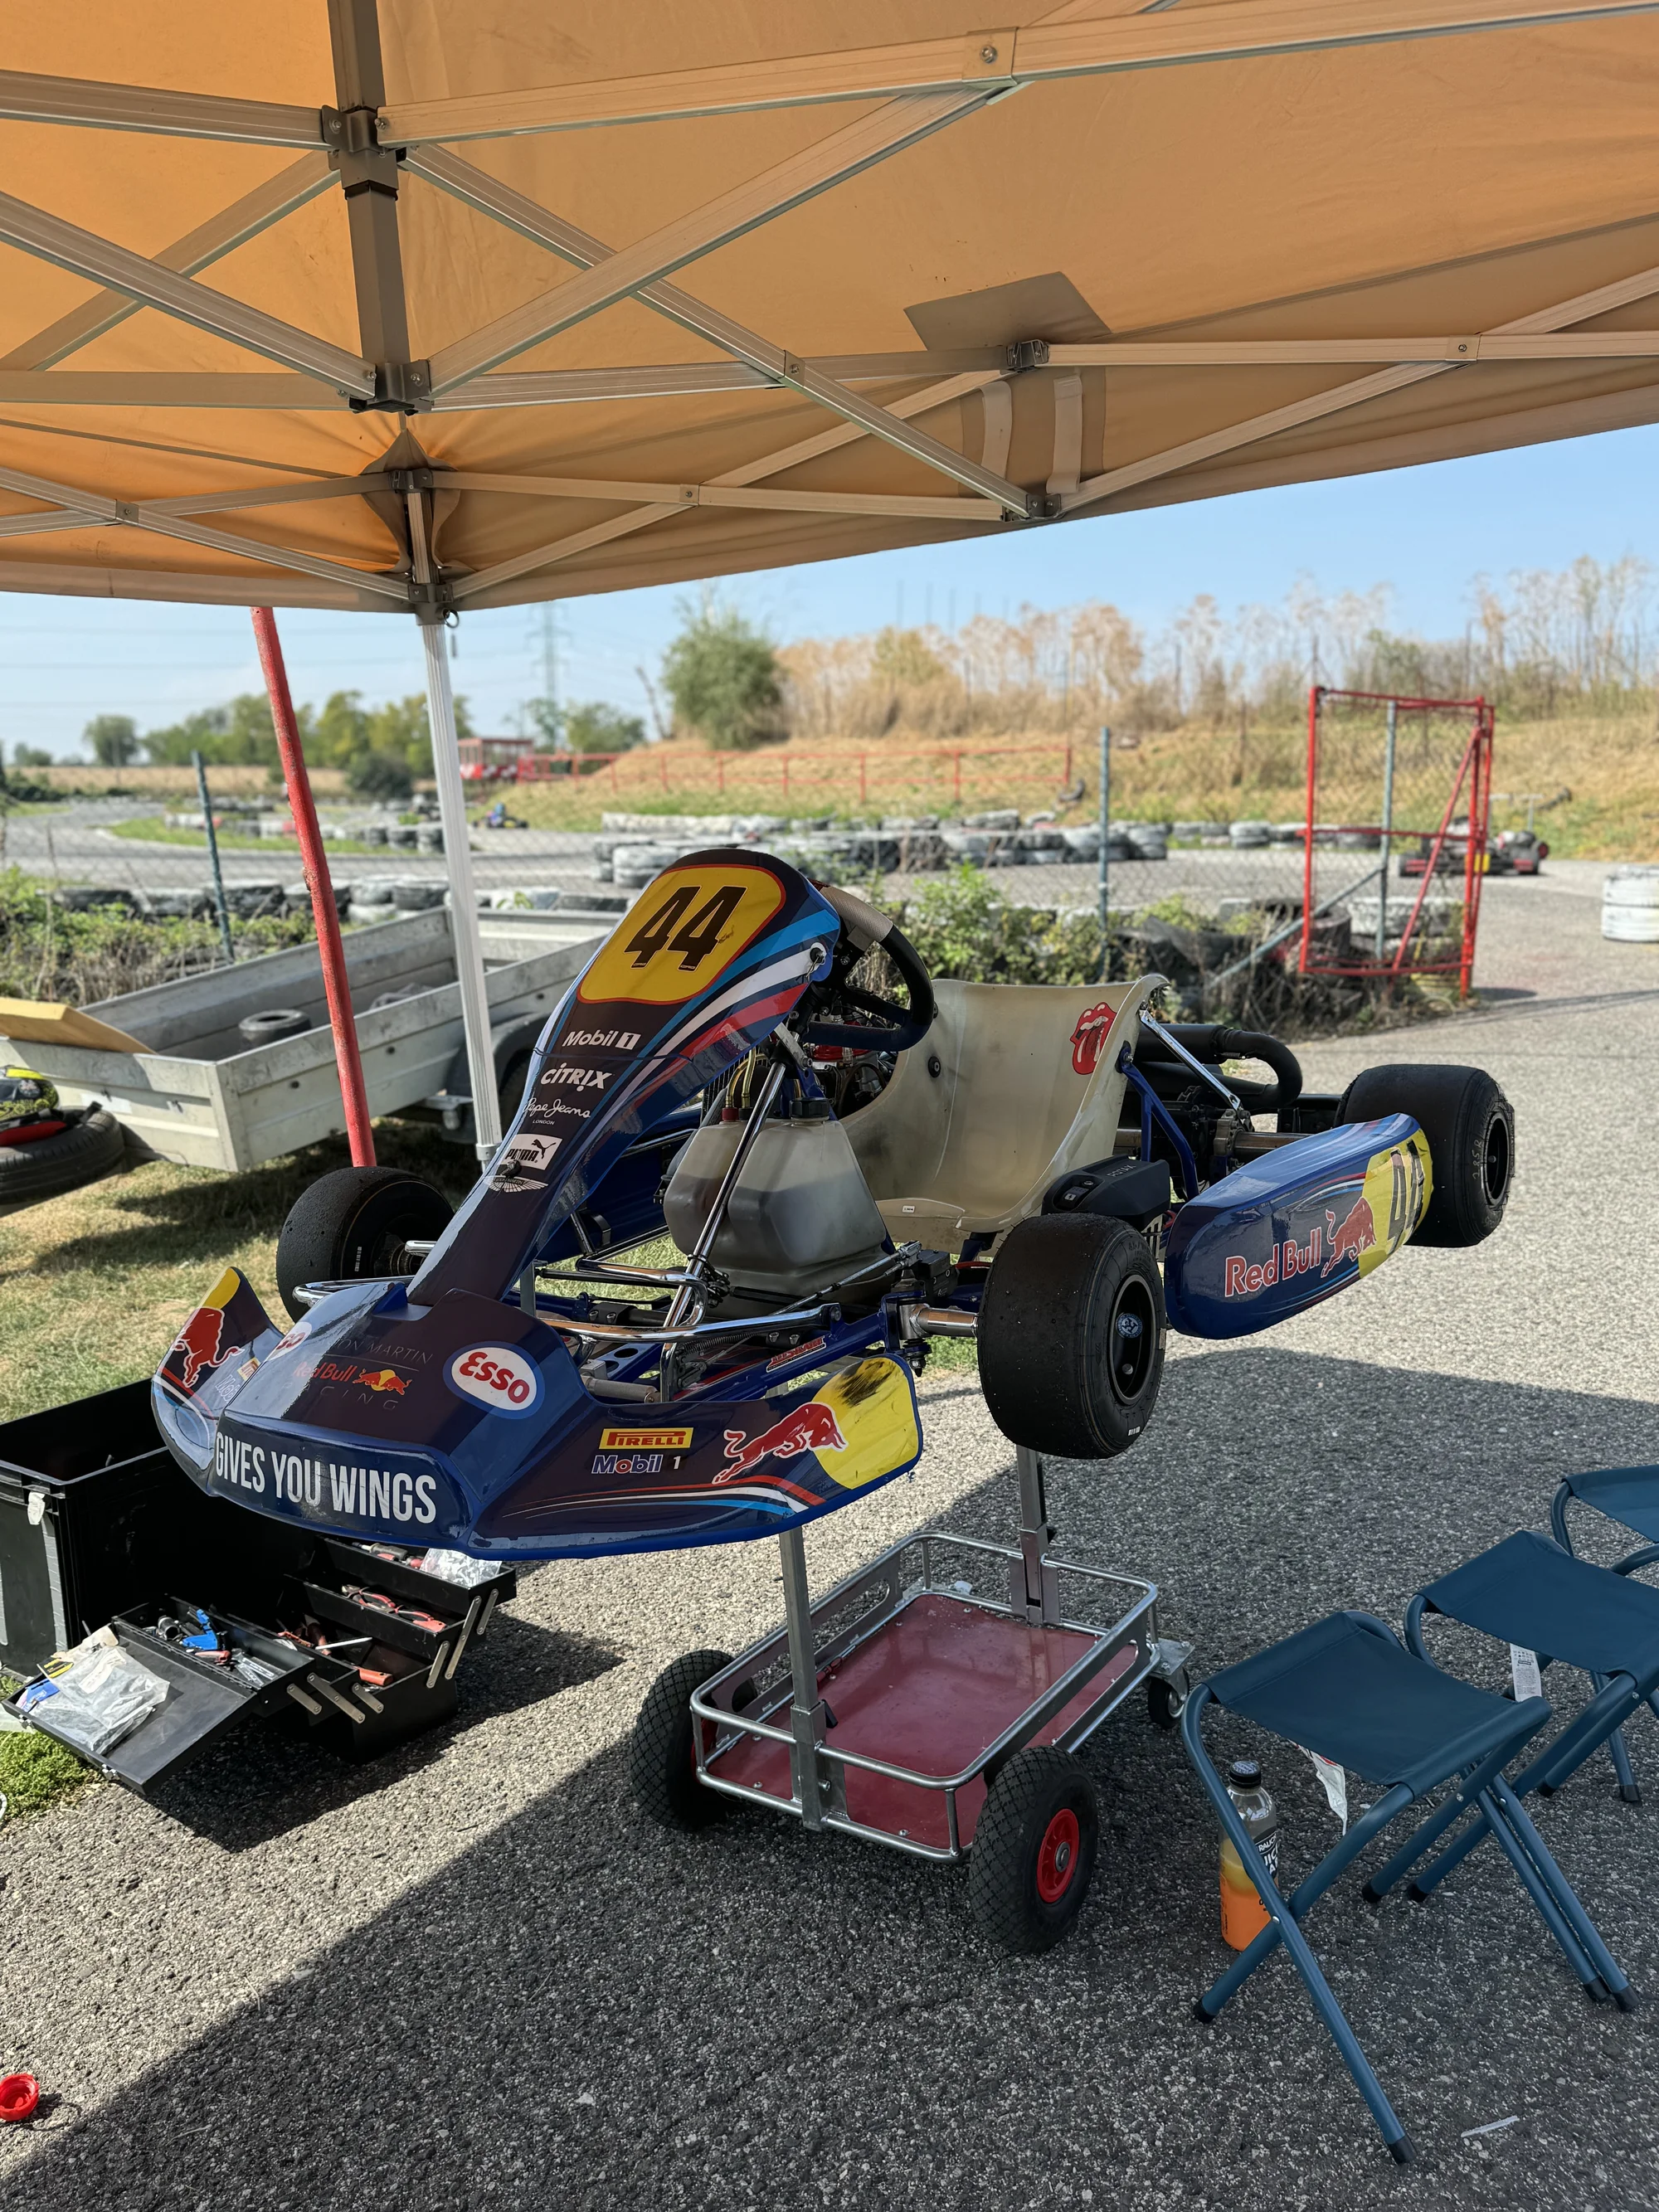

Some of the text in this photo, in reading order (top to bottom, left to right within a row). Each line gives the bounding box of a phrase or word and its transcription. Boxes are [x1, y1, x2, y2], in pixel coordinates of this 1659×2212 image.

[624, 884, 748, 972] 44
[562, 1029, 619, 1047] Mobil
[523, 1097, 591, 1118] Pepe Jeans
[1224, 1227, 1322, 1298] Red Bull
[368, 1342, 433, 1364] MARTIN
[319, 1363, 358, 1383] Bull
[606, 1431, 687, 1446] PIRELLI
[591, 1454, 682, 1474] Mobil 1
[215, 1431, 437, 1524] GIVES YOU WINGS
